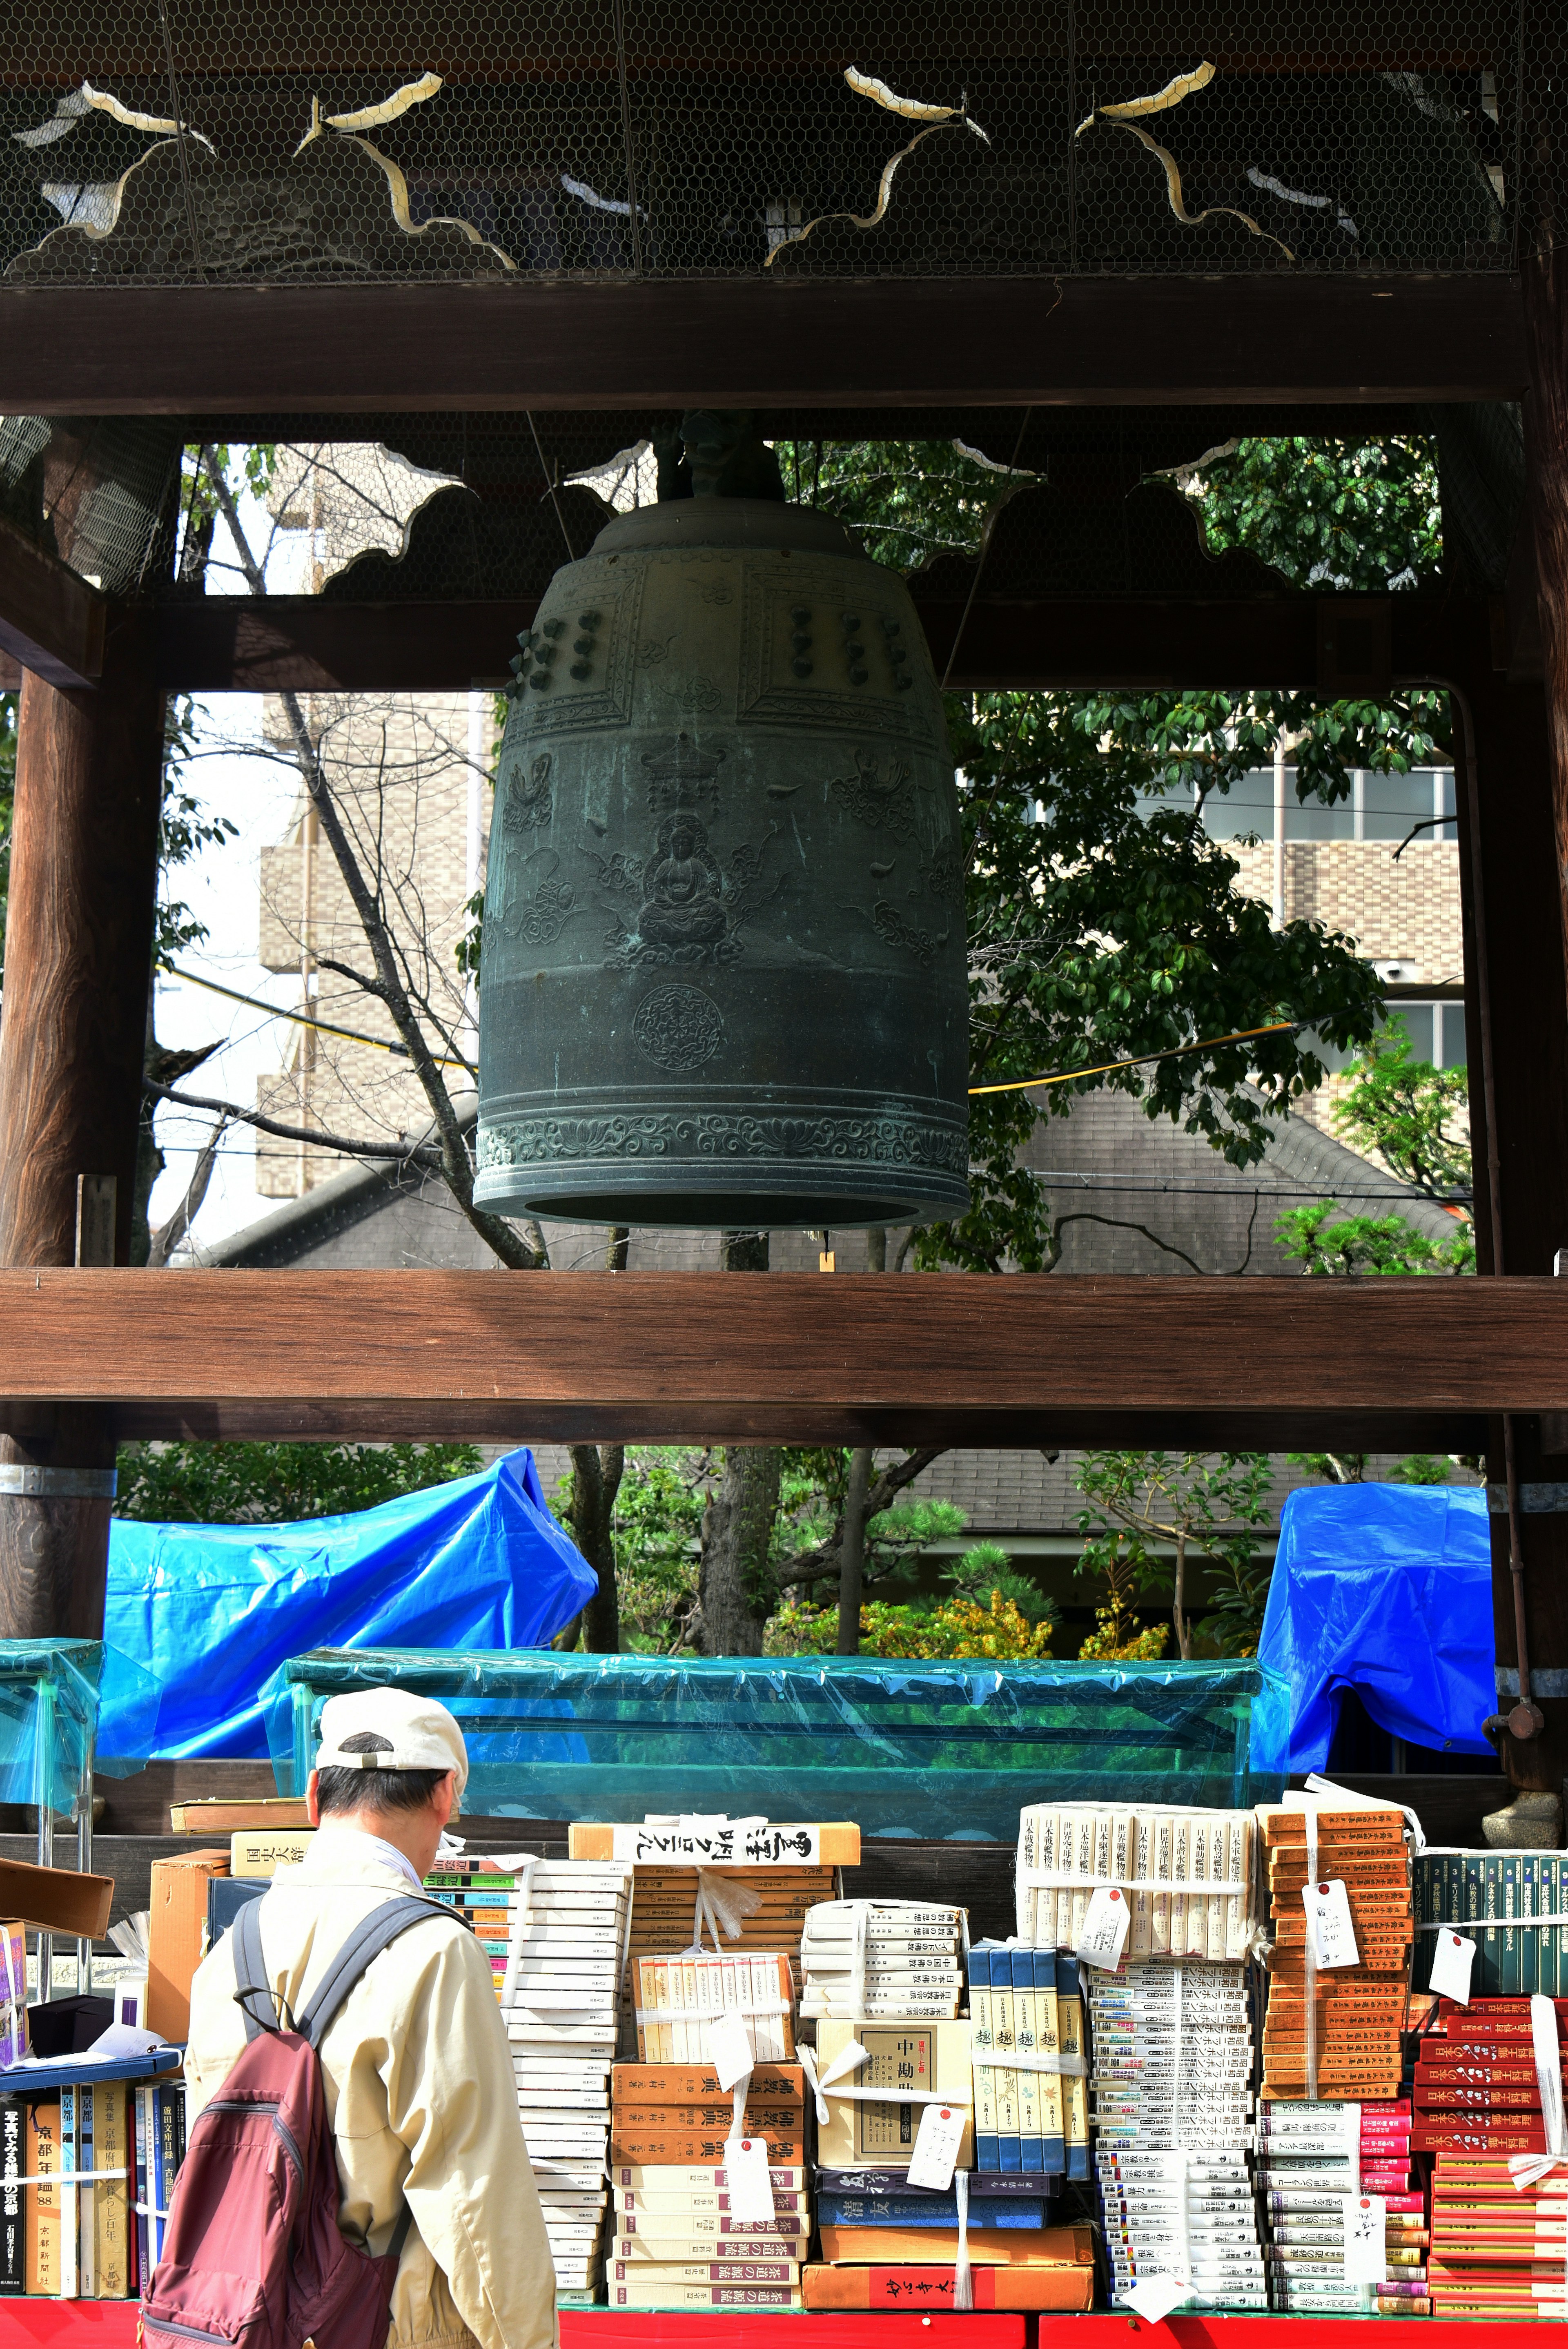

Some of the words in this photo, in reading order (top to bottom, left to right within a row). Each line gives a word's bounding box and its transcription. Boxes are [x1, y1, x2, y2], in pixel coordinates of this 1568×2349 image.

[246, 1847, 308, 1863] 国史大辞
[1487, 1881, 1495, 1941] ルネサンスの間像
[1523, 1883, 1532, 1932] 市民社会の立
[1505, 1883, 1514, 1951] 東洋封建社のモラル
[1492, 2069, 1533, 2082] 郷土料理
[1490, 2091, 1532, 2104] 郷土料理
[700, 2109, 795, 2127] 佛教語辞典
[1491, 2113, 1532, 2126] 郷土料理
[1488, 2136, 1529, 2149] 郷土料理
